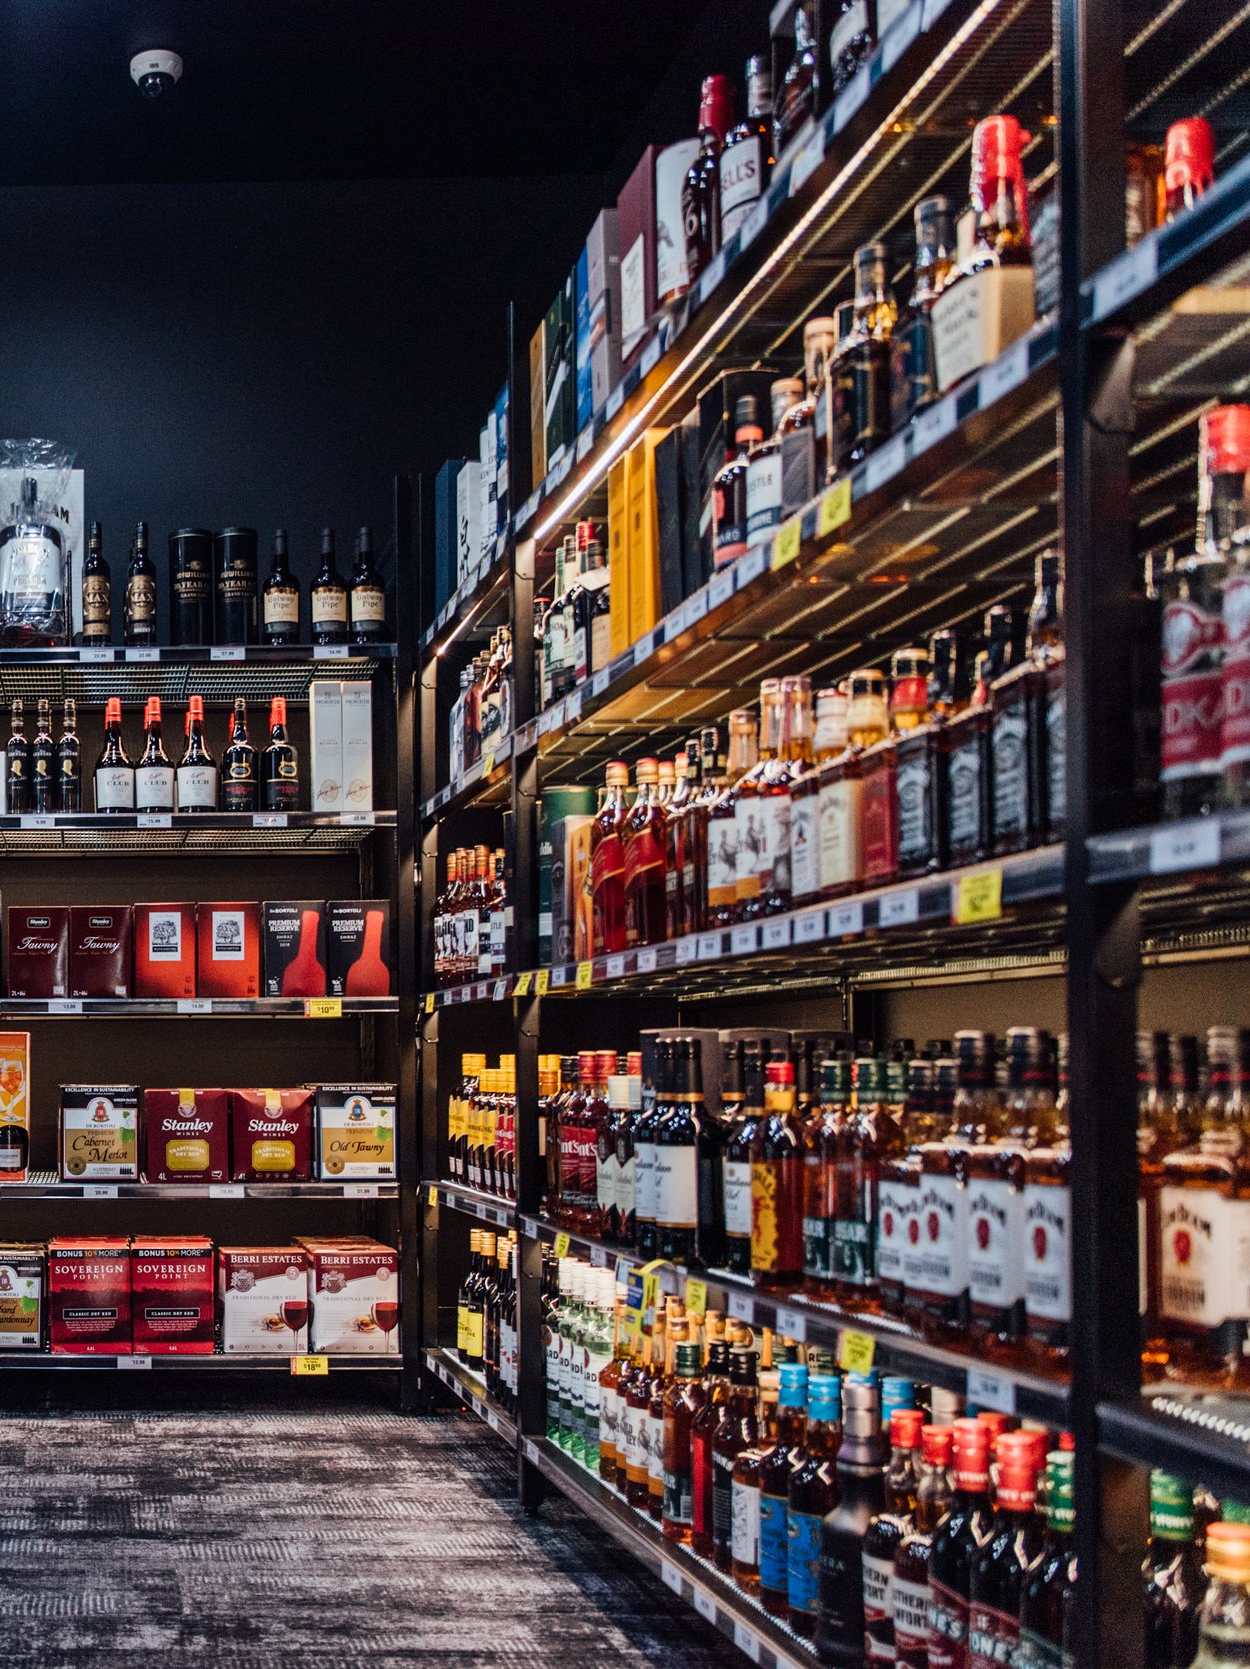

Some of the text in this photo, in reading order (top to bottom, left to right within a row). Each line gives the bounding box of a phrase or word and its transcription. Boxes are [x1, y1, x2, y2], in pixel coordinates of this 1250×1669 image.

[268, 596, 295, 604] Galway
[316, 595, 343, 603] Galway
[356, 594, 383, 602] Galway
[17, 936, 59, 954] Tawny
[79, 936, 120, 954] Tawny
[161, 1118, 213, 1134] Stanley
[248, 1119, 300, 1135] Stanley
[72, 1135, 115, 1151] Cabernet
[329, 1140, 385, 1156] Old Tawny
[88, 1148, 128, 1163] Merlot
[158, 1173, 167, 1181] 4L
[56, 1250, 83, 1258] BONUS
[138, 1249, 165, 1257] BONUS
[166, 1249, 180, 1257] 10%
[230, 1255, 303, 1264] BERRI ESTATES
[320, 1256, 393, 1264] BERRI ESTATES
[55, 1264, 124, 1274] SOVEREIGN
[137, 1264, 206, 1274] SOVEREIGN
